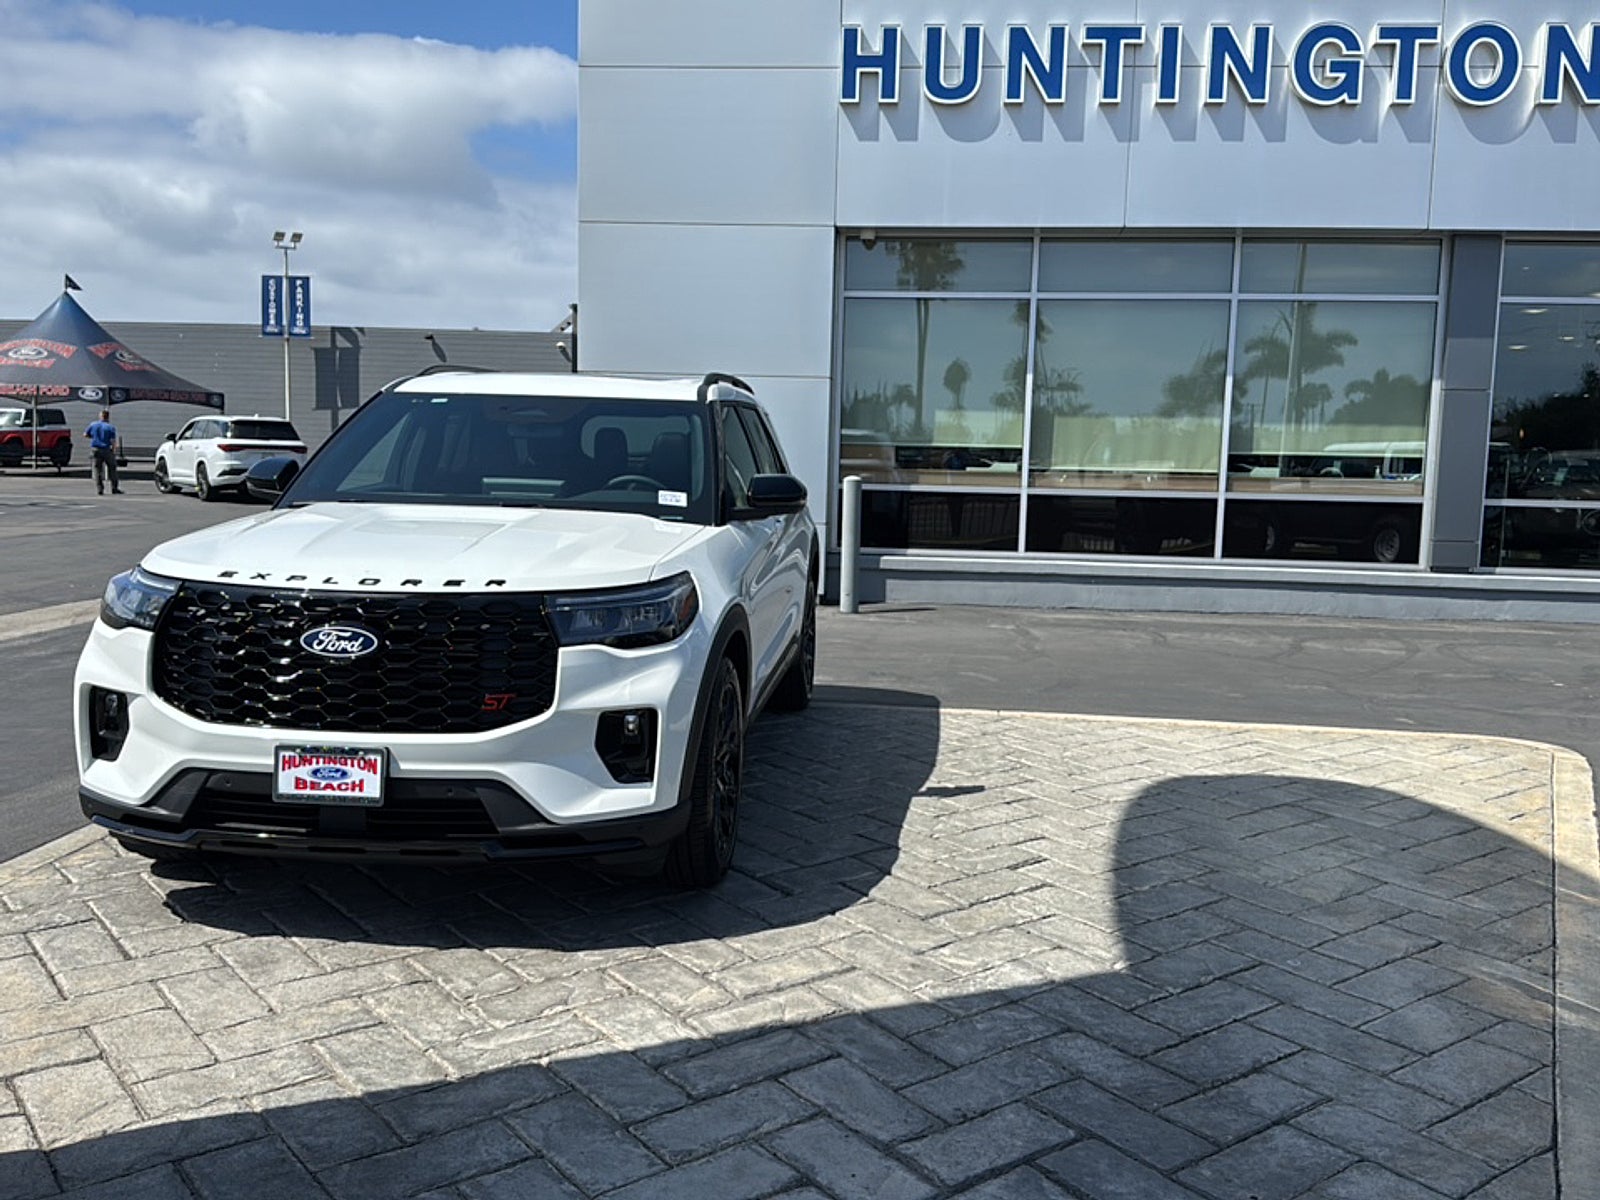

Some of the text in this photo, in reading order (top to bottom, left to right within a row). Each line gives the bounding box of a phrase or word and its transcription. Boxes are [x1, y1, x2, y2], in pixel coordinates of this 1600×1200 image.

[839, 23, 1600, 105] HUNTINGTON
[295, 279, 304, 327] PARKING
[217, 570, 507, 588] EXPLORER
[311, 628, 365, 653] Ford
[481, 692, 517, 711] ST
[282, 753, 378, 775] HUNTINGTON
[294, 776, 365, 793] BEACH
